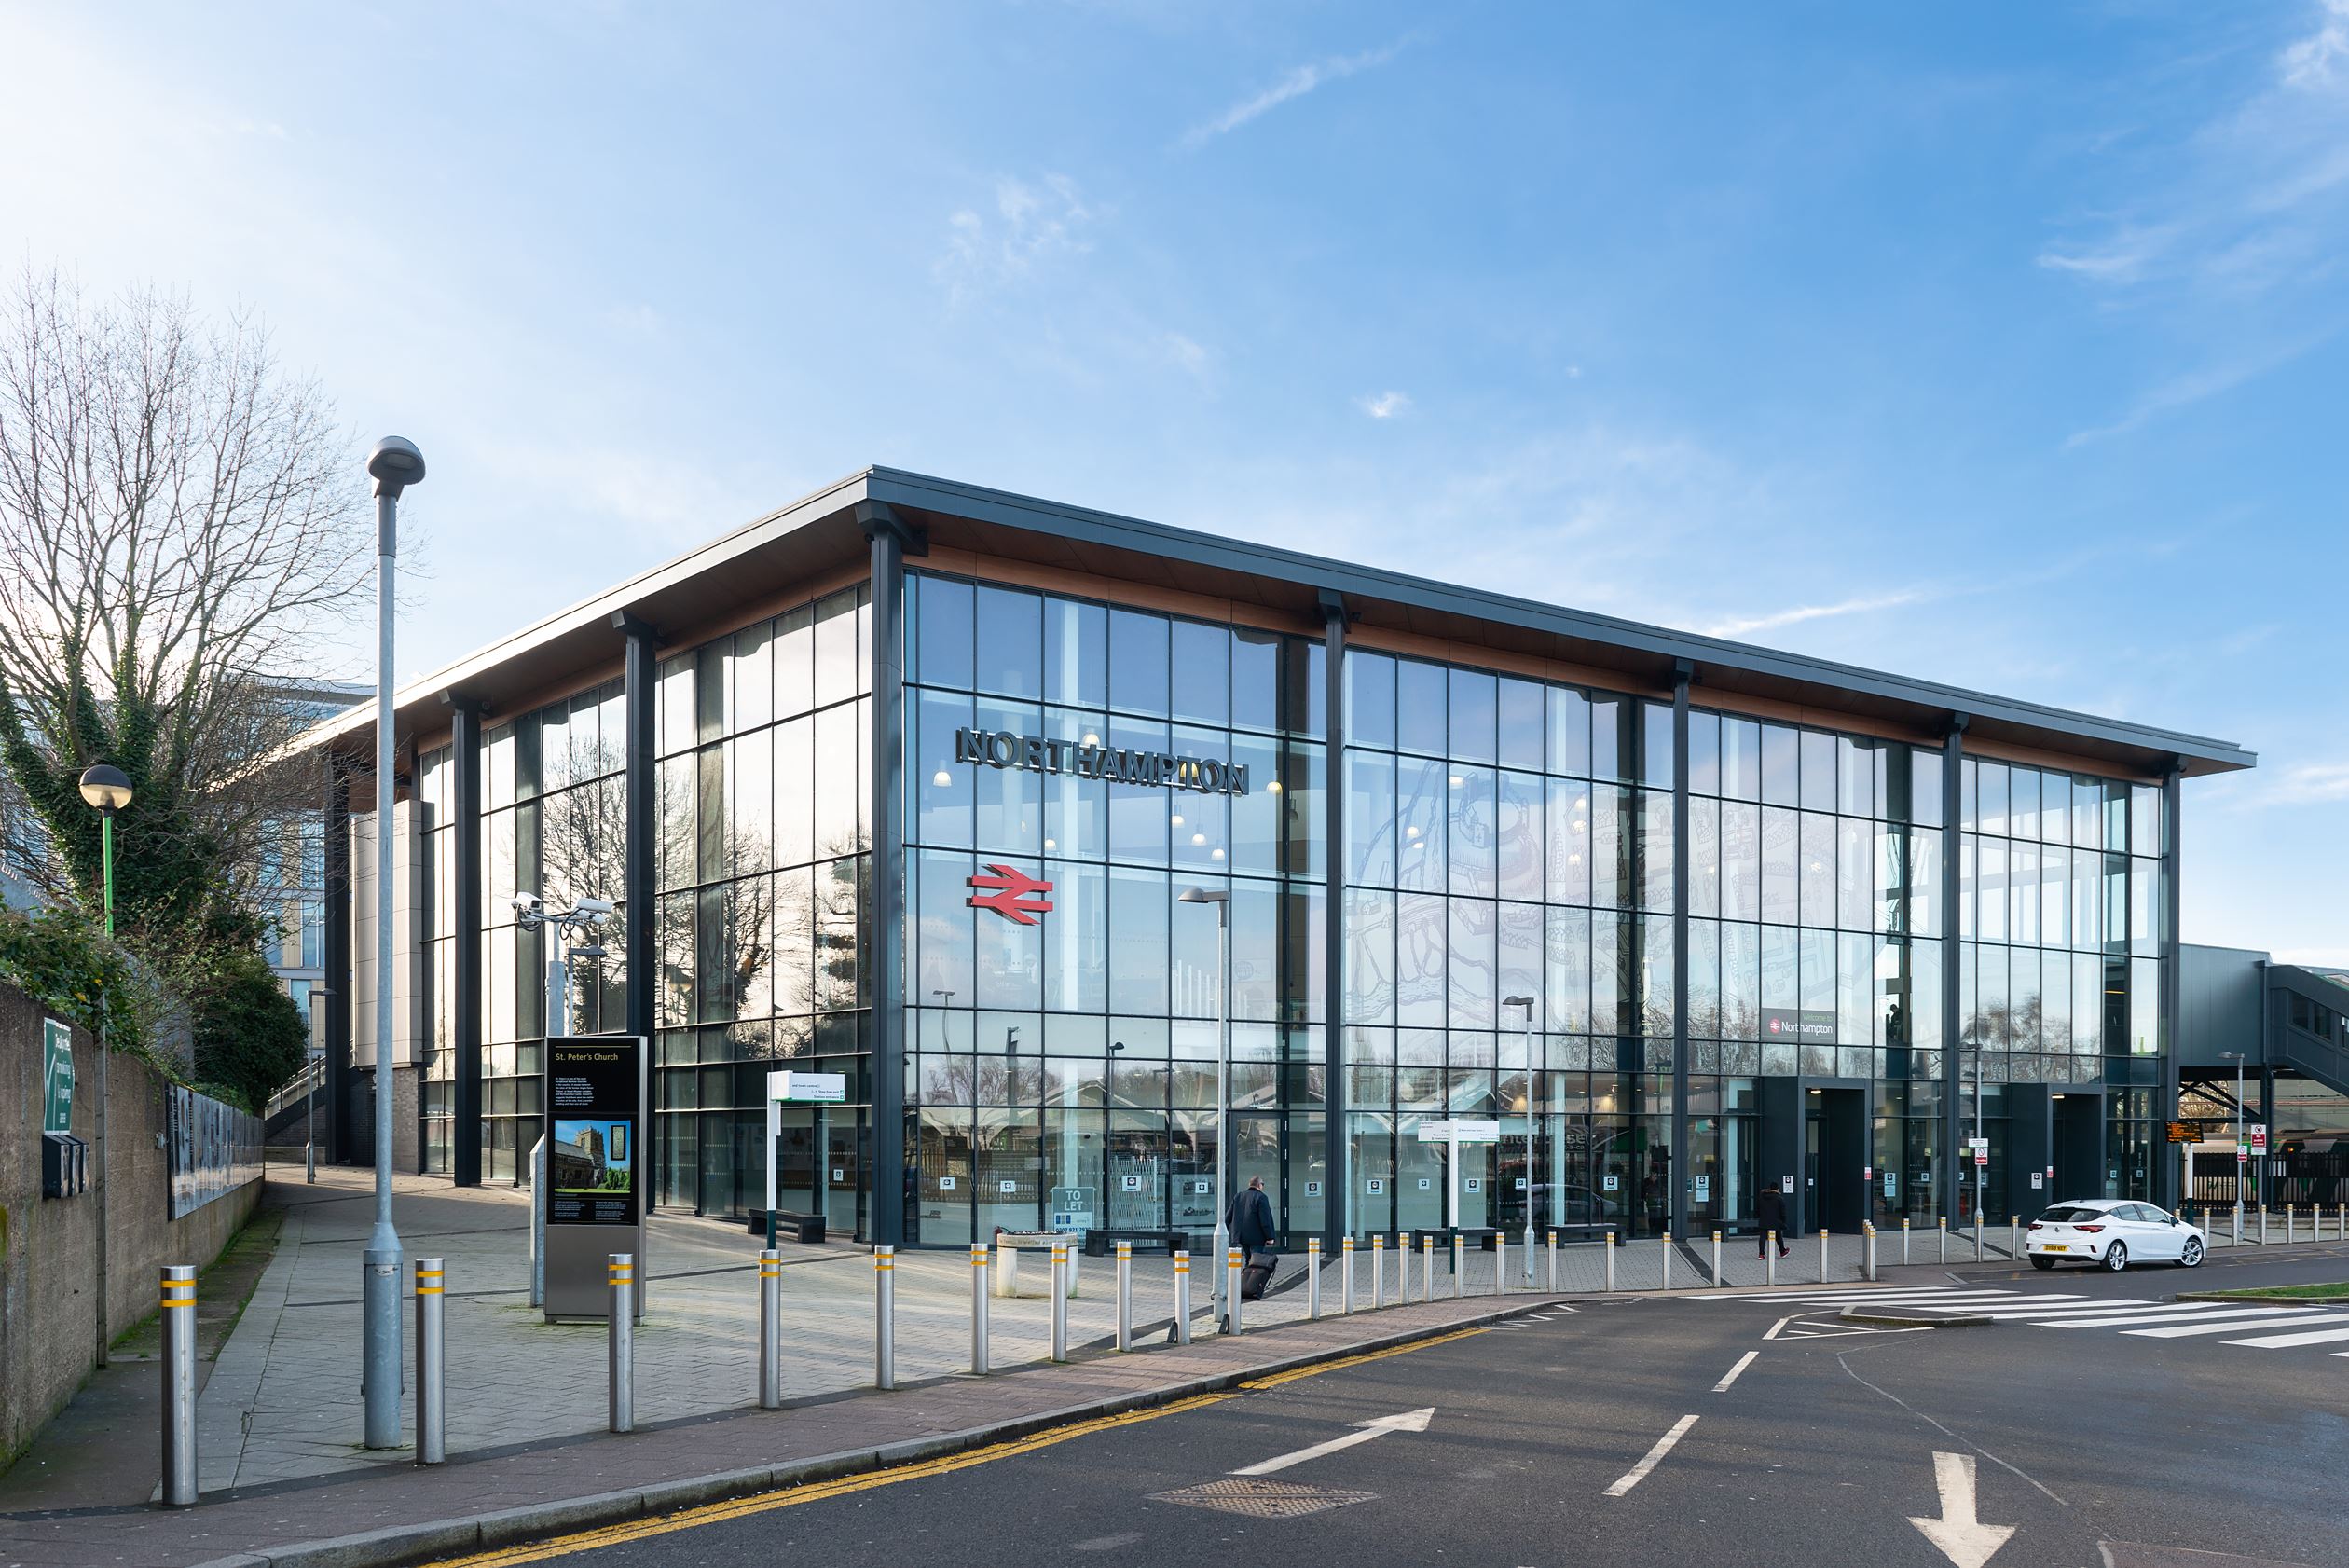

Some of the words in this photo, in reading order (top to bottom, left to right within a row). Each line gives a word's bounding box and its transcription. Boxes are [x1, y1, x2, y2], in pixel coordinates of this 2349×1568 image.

[959, 727, 1249, 795] NORTHAMPTON
[1803, 1013, 1826, 1022] Welcome
[1781, 1021, 1833, 1036] Northampton
[1065, 1190, 1081, 1201] TO
[1064, 1201, 1084, 1211] LET
